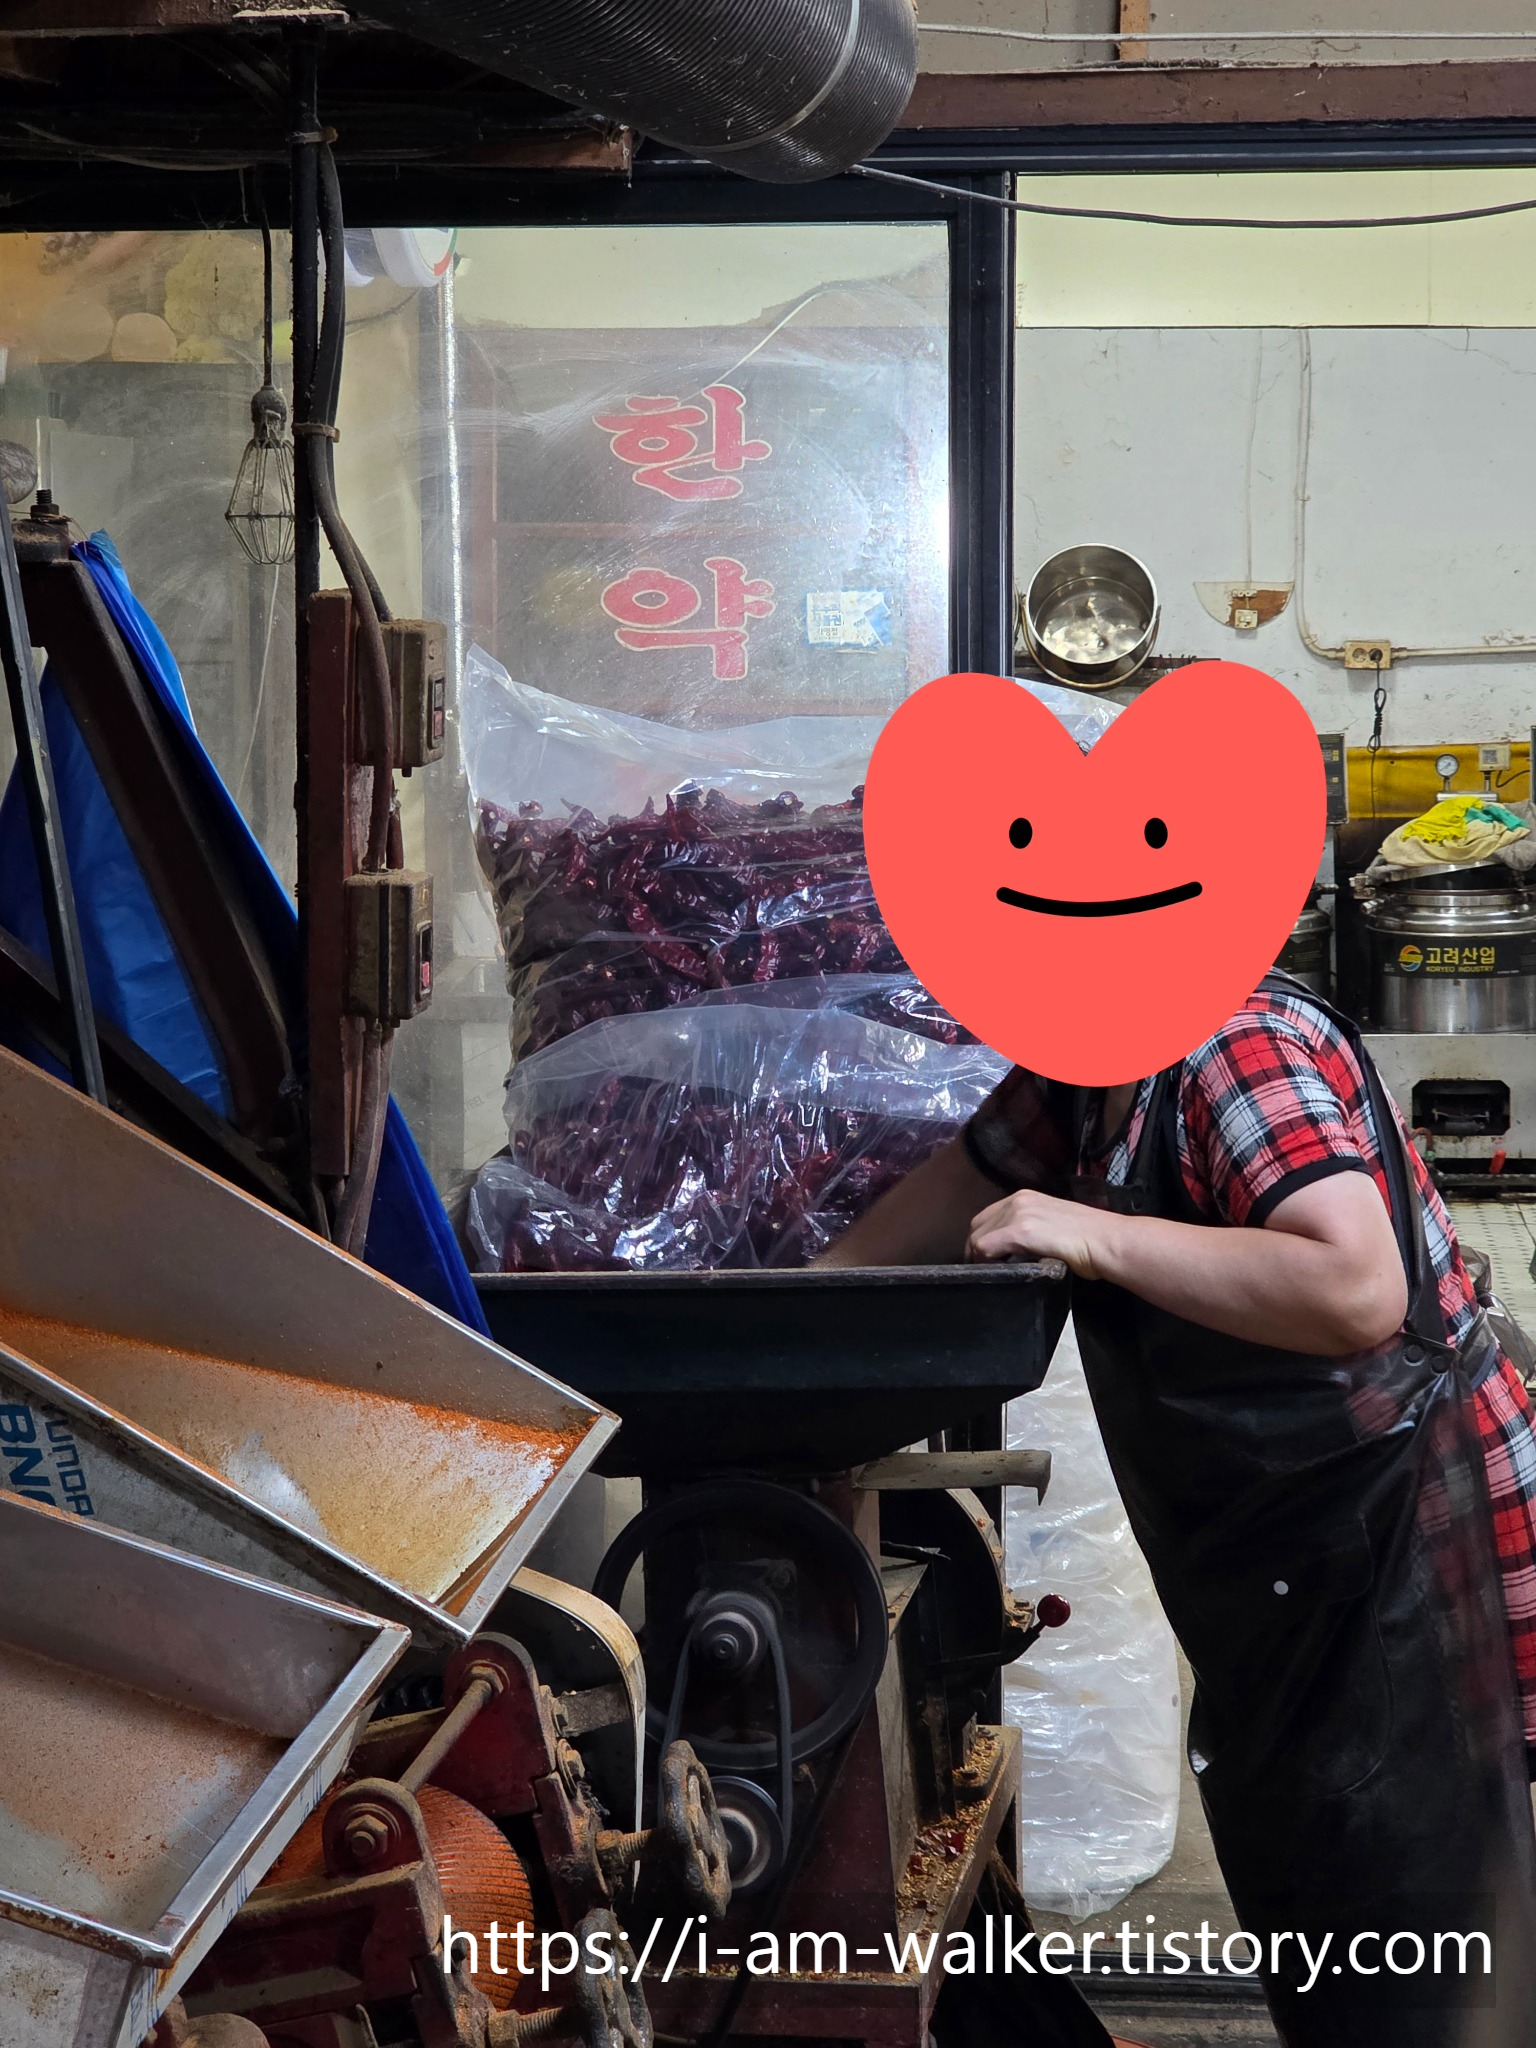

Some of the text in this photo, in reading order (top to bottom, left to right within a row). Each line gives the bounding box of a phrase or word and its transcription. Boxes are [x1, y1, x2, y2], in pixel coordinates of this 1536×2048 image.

[592, 383, 776, 680] 한약
[1425, 946, 1495, 965] 고려산업
[1425, 965, 1456, 973] KORYEO
[1458, 965, 1495, 973] INDUSTRY
